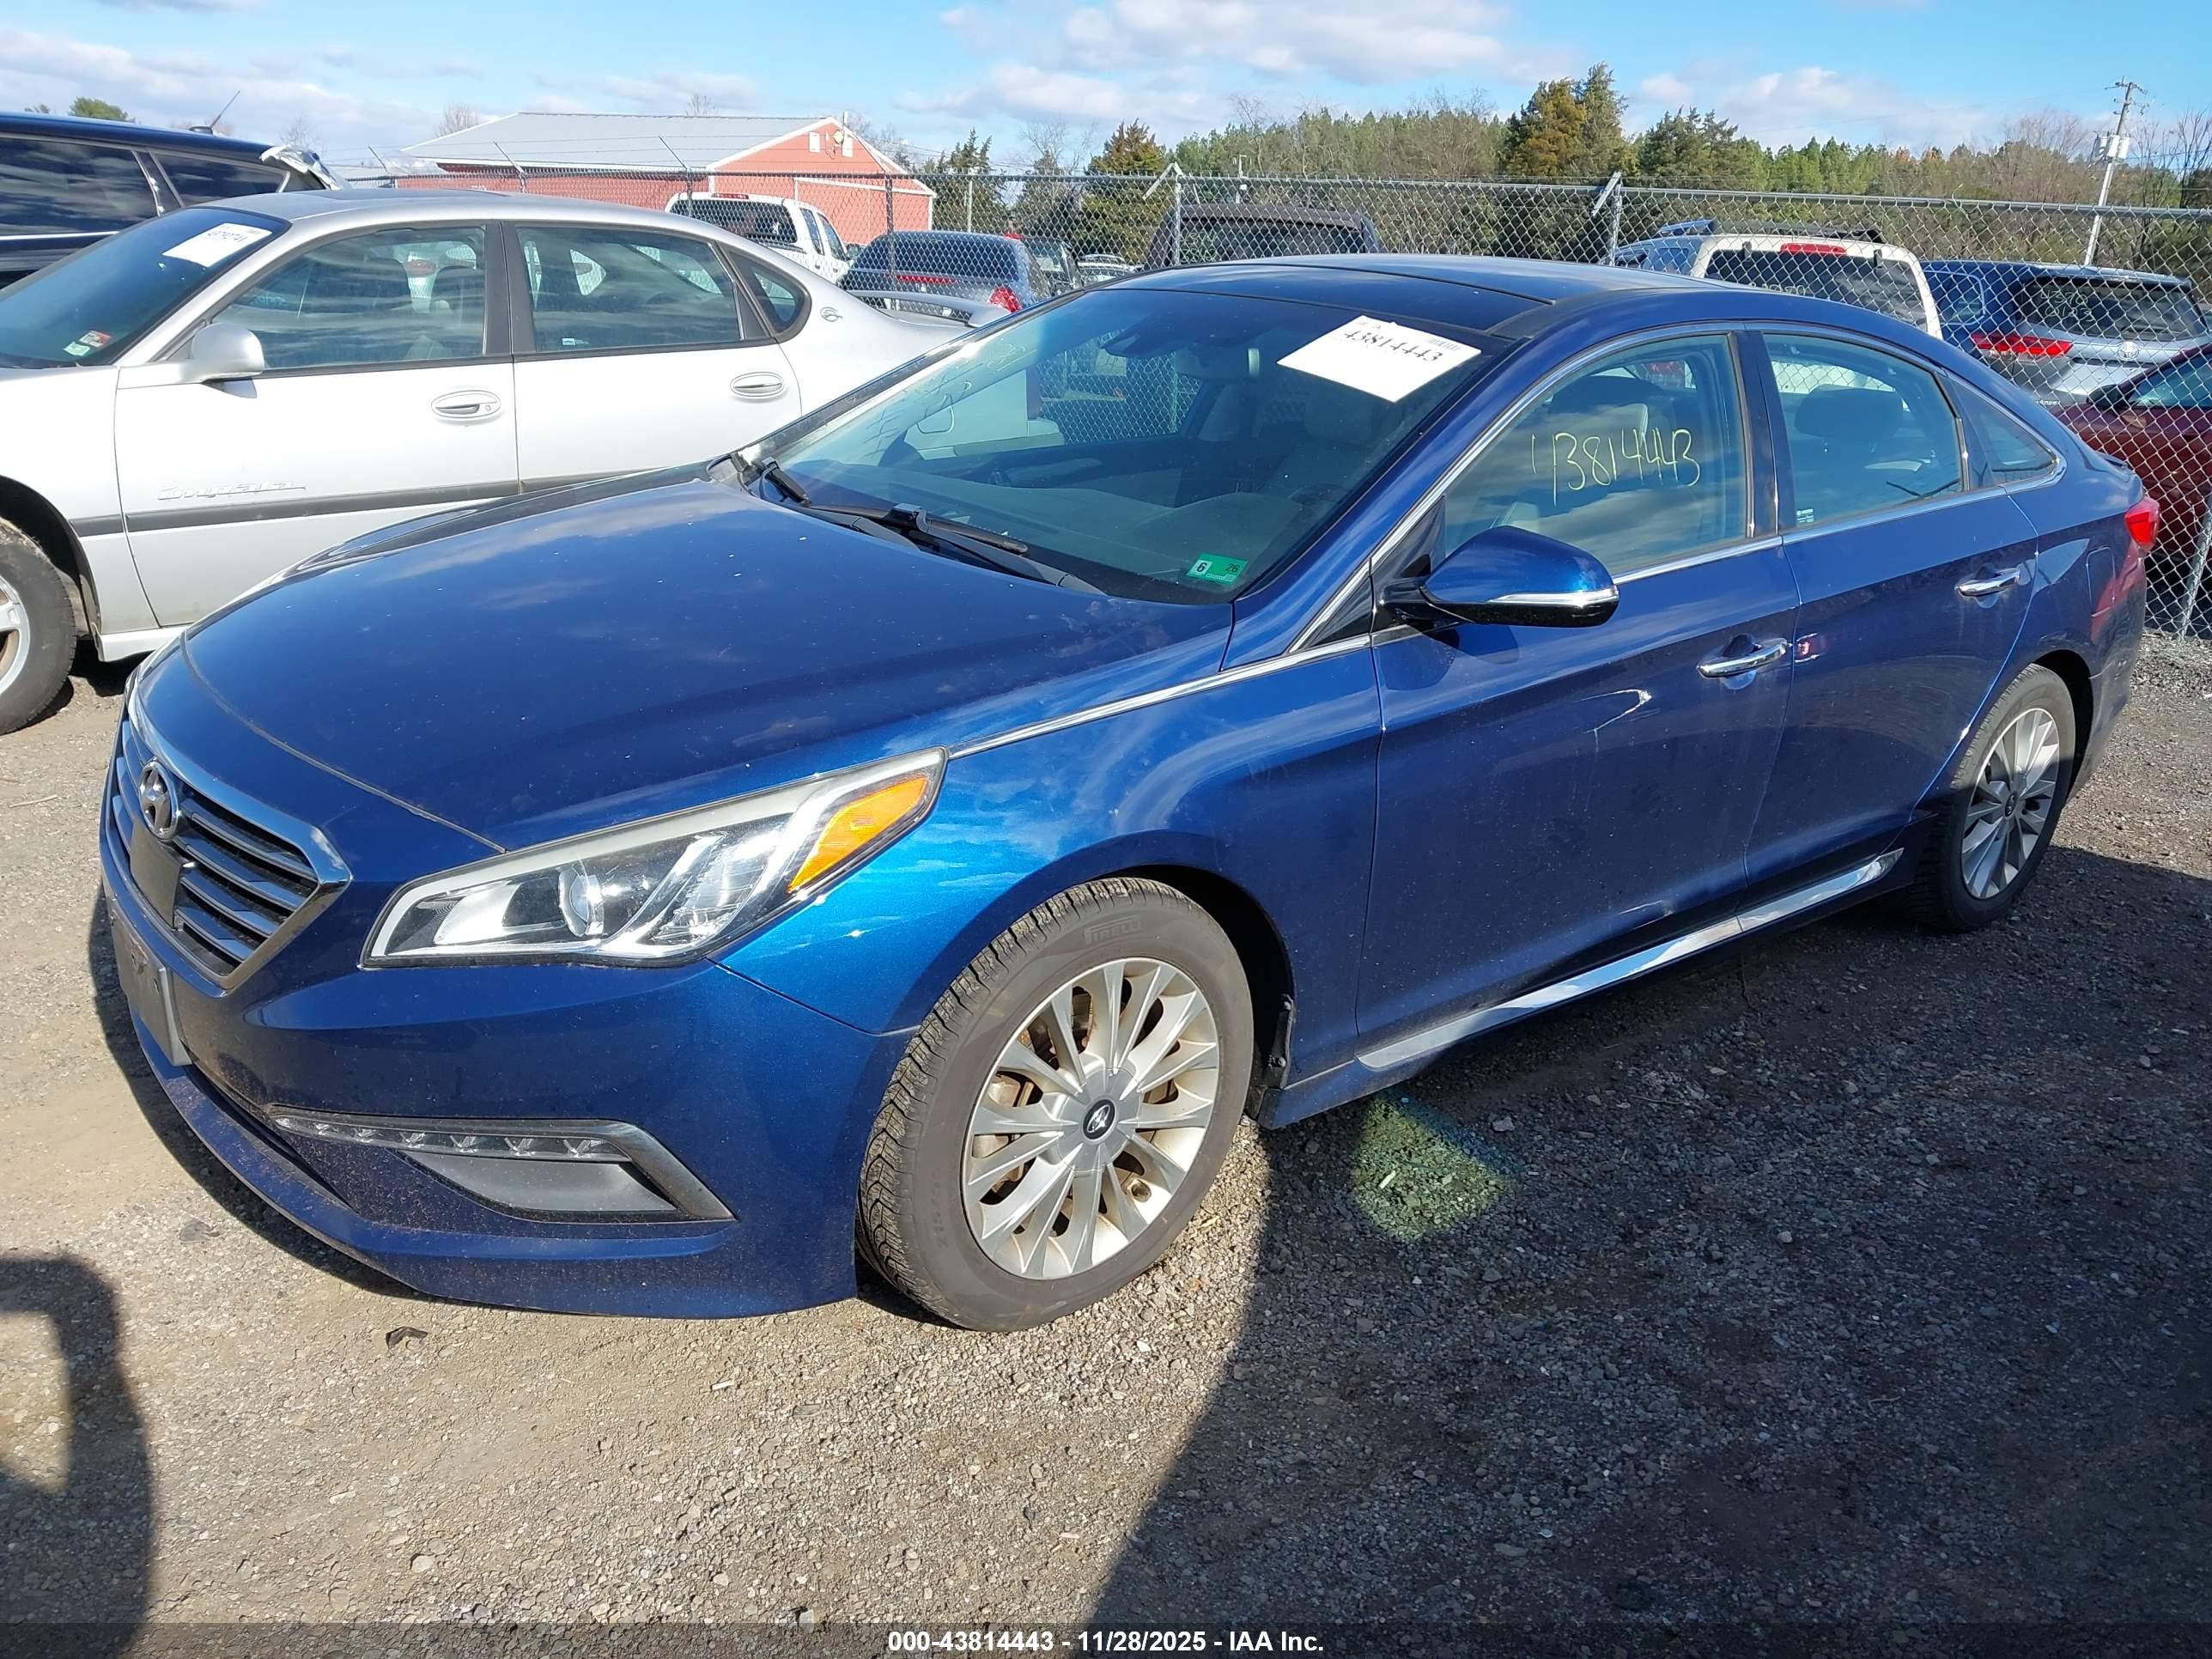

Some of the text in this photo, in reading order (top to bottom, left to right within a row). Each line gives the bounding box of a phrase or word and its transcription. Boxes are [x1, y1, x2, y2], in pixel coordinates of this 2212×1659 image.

[1343, 330, 1443, 362] 43814443
[1197, 562, 1240, 573] 6 26
